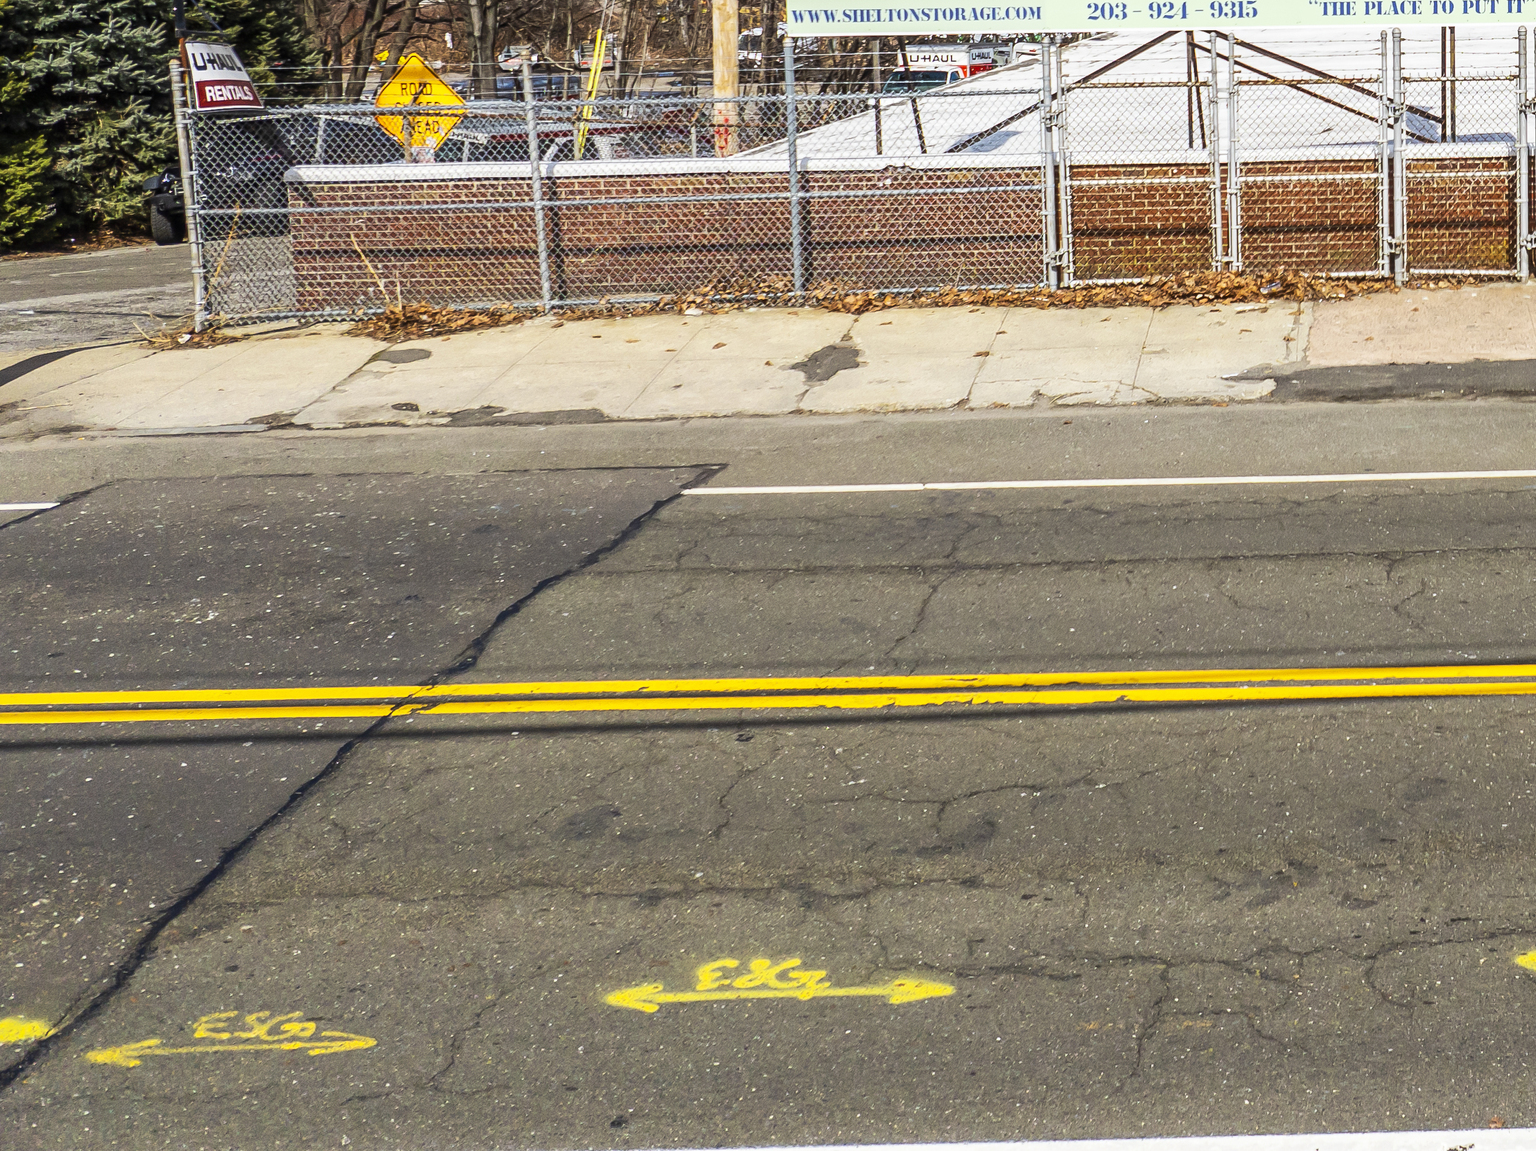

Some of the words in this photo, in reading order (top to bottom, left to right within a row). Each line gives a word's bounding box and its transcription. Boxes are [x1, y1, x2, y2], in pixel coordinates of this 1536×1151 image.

[791, 6, 1042, 23] WWW.SHELTONSTORAGE.COM
[1364, 0, 1423, 16] PLACE
[1429, 0, 1455, 15] TO
[1462, 0, 1499, 15] PUT
[191, 52, 244, 72] U-HAUL
[909, 54, 957, 63] U-HAUL
[205, 85, 254, 102] RENTALS
